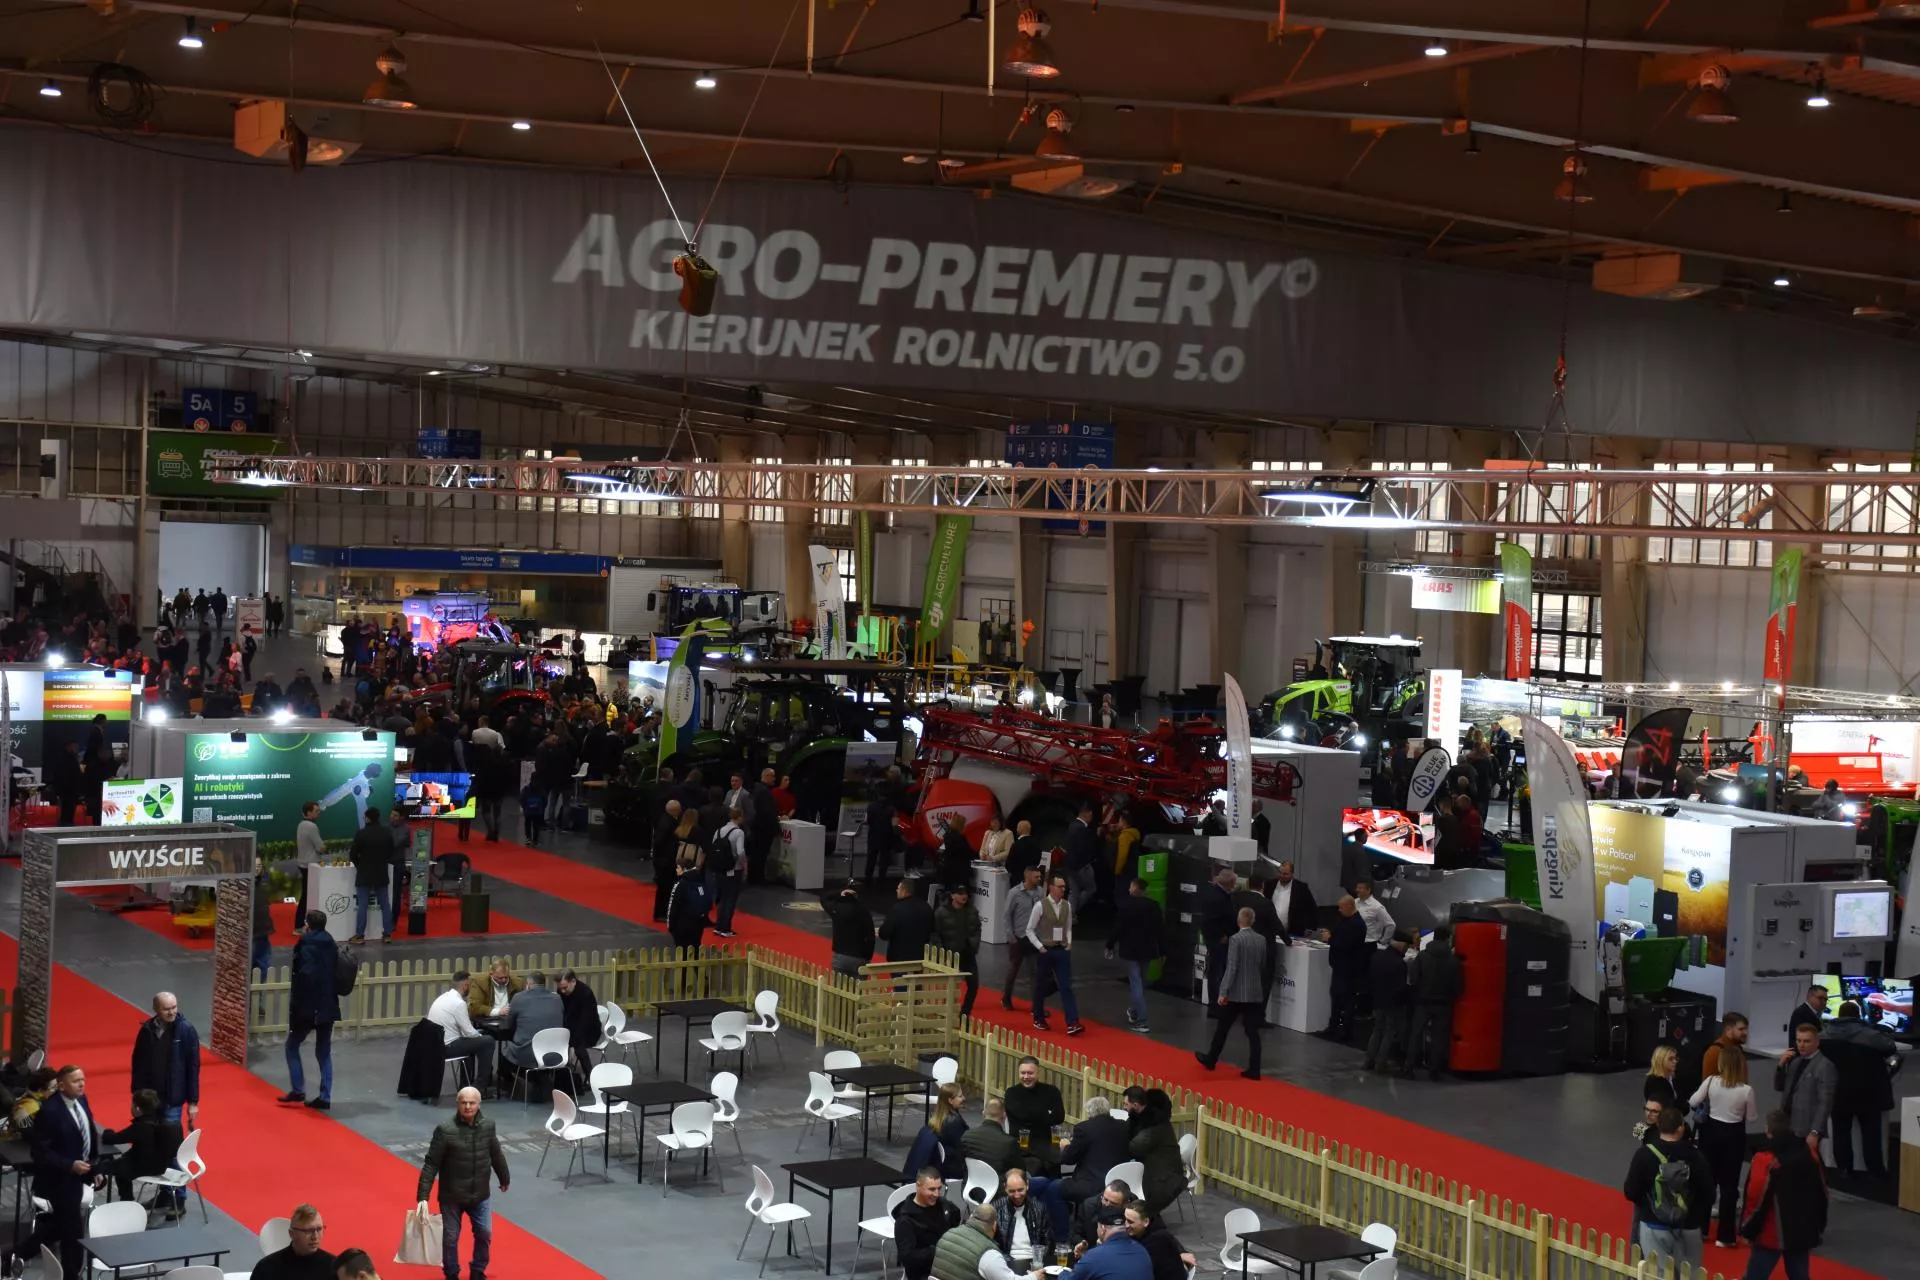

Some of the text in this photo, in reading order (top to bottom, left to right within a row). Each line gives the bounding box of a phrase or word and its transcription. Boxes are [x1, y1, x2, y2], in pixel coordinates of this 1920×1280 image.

[629, 309, 1245, 385] KIERUNEK ROLNICTWO 5.0
[190, 393, 213, 412] 5A
[233, 396, 246, 414] 5
[1082, 425, 1090, 435] D
[936, 522, 958, 600] AGRICULTURE
[1424, 755, 1439, 773] BLUE
[1431, 755, 1447, 777] CLEAN
[194, 783, 203, 792] AI
[210, 782, 245, 792] robotyki
[228, 792, 263, 800] rzeczywistych
[109, 844, 204, 869] WYJŚCIE
[1608, 847, 1636, 861] Polsce!
[1681, 847, 1711, 859] Kingspan
